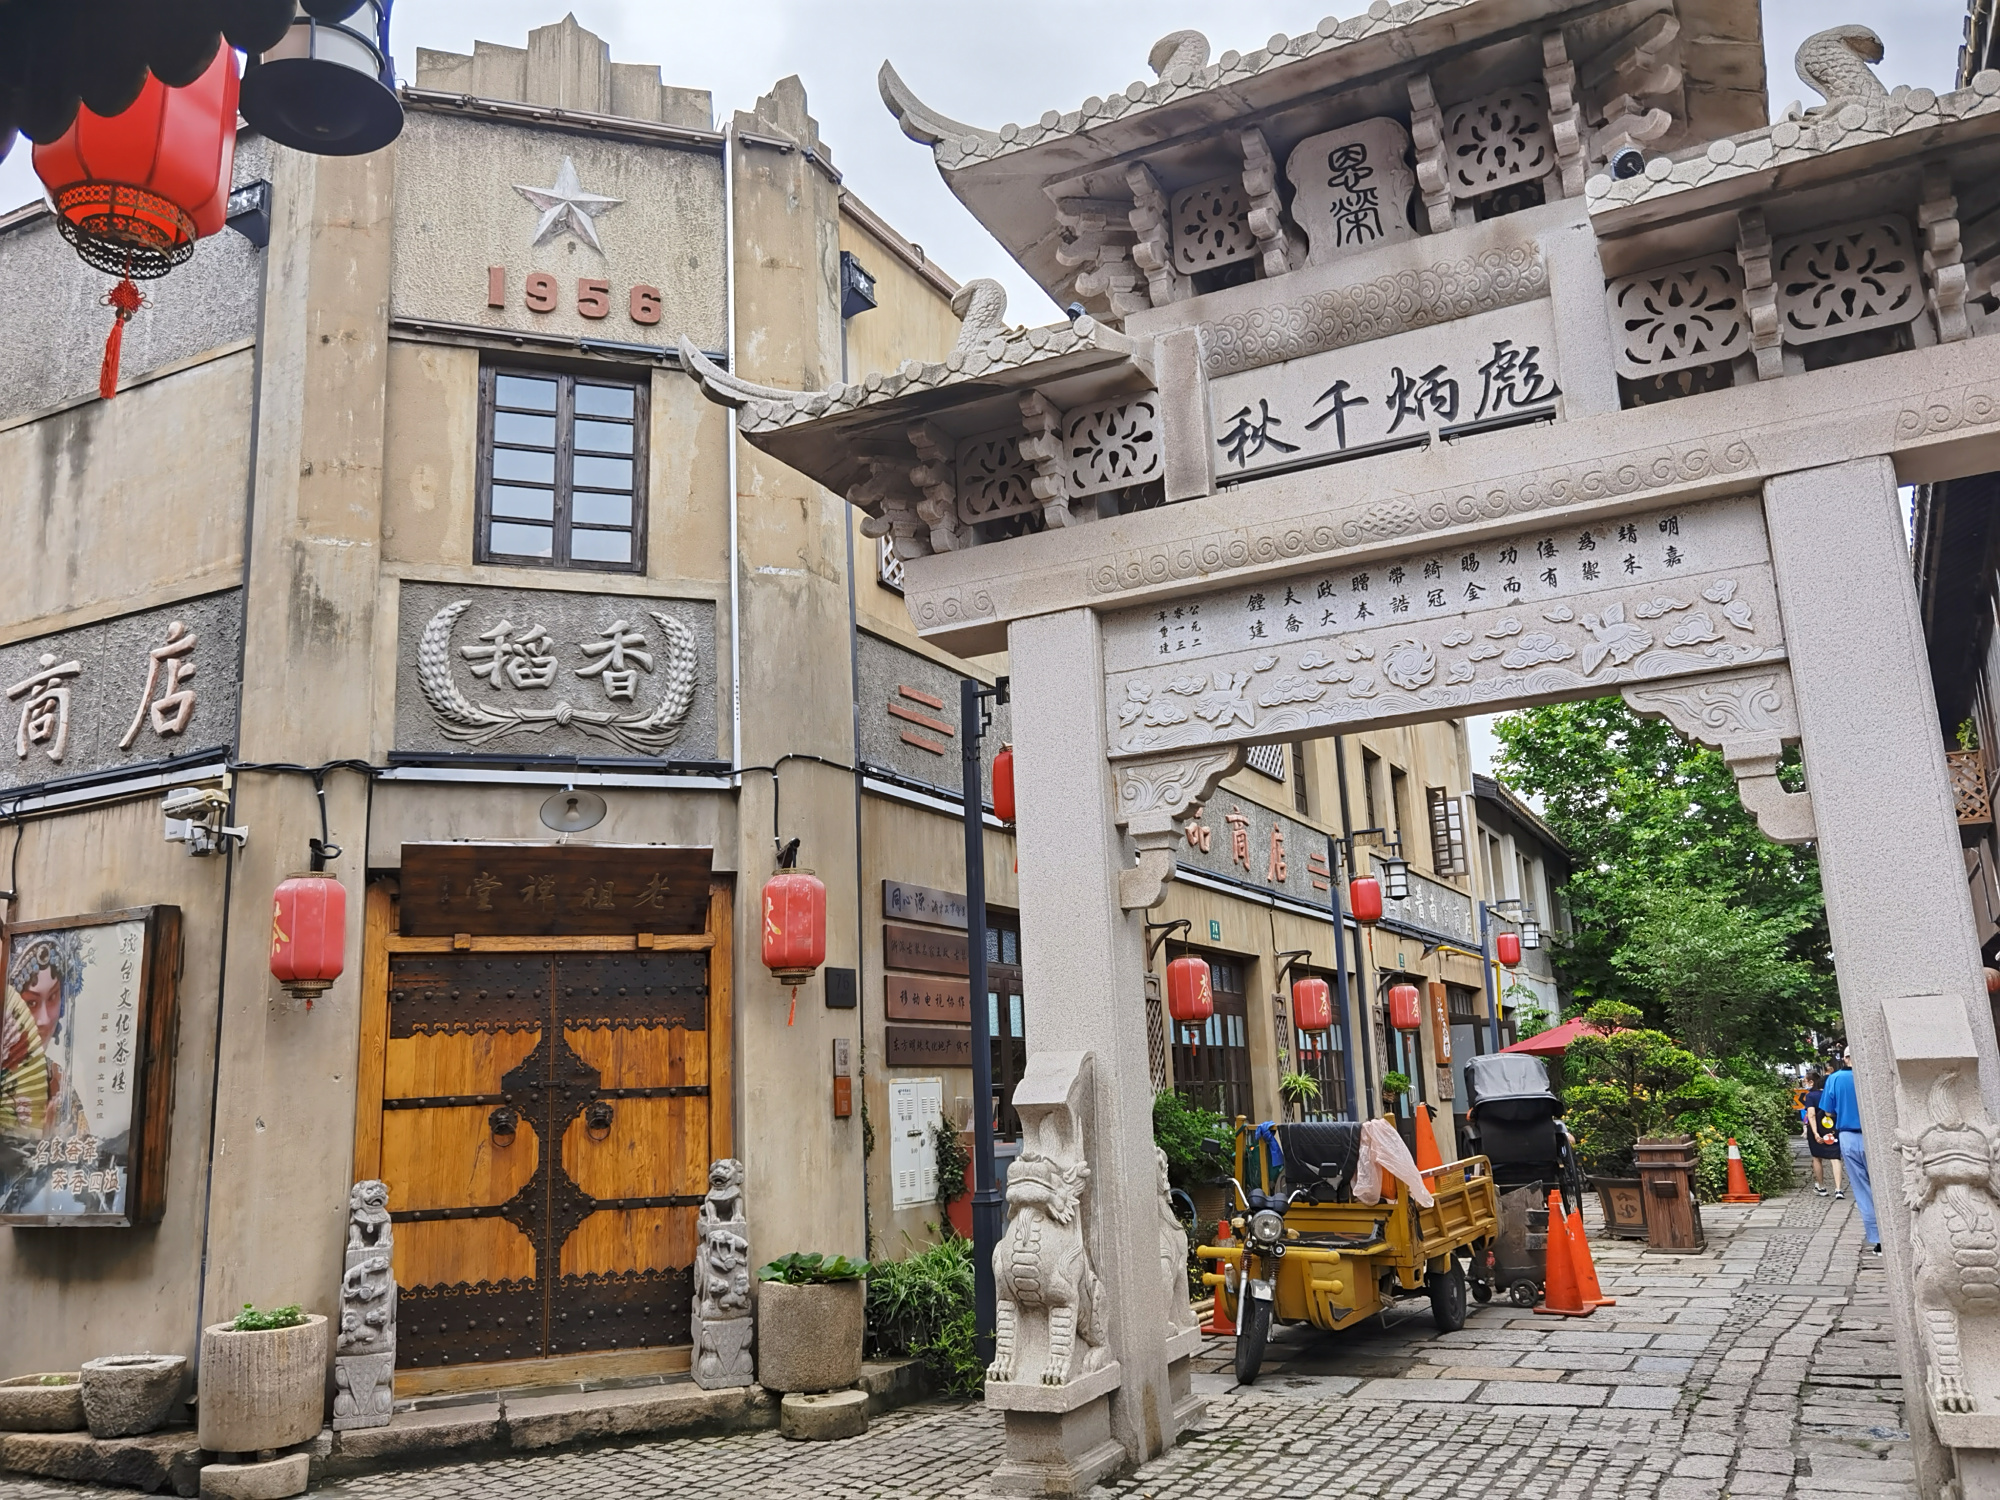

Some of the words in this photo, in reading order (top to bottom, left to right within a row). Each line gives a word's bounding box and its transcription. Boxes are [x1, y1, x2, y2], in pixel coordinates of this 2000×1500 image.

[487, 265, 661, 324] 1956
[4, 620, 199, 763] 商店
[460, 619, 654, 702] 稻香
[835, 974, 850, 991] 76
